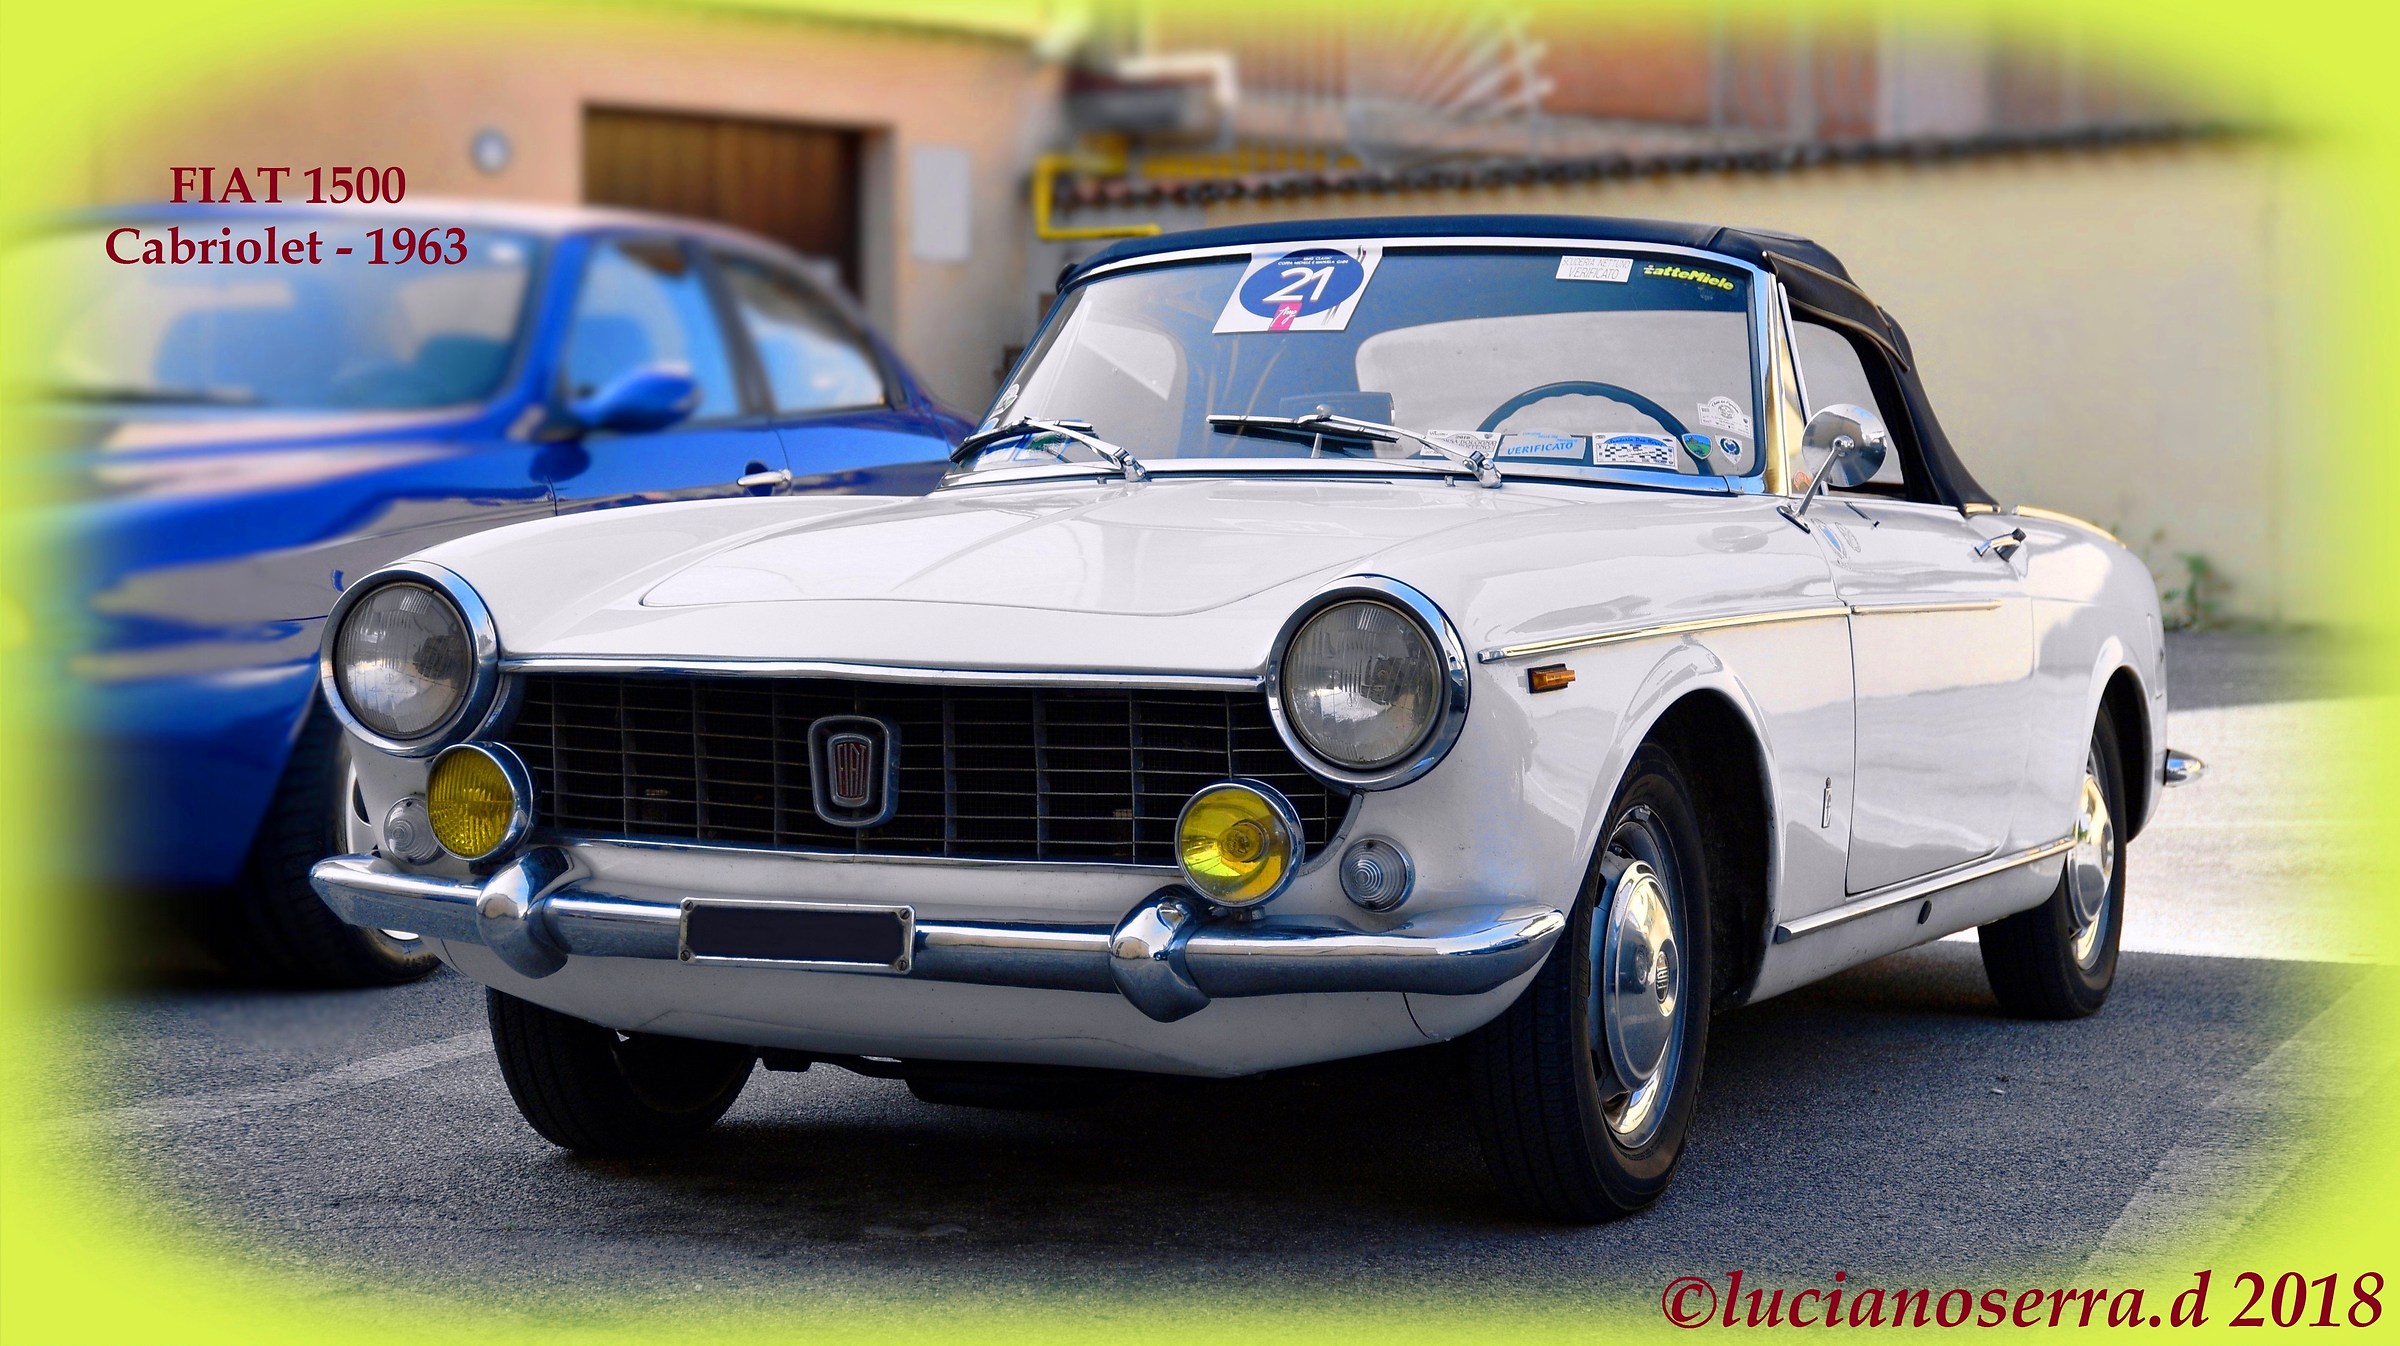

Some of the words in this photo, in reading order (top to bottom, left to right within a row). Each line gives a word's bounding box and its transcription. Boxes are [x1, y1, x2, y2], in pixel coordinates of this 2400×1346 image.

[1562, 258, 1595, 267] SCUDERIA
[1568, 267, 1620, 280] VERIFICATO
[1262, 266, 1334, 302] 21
[1507, 442, 1574, 455] VERIFICATO
[837, 743, 867, 797] FIAT
[1656, 966, 1668, 989] FIAT
